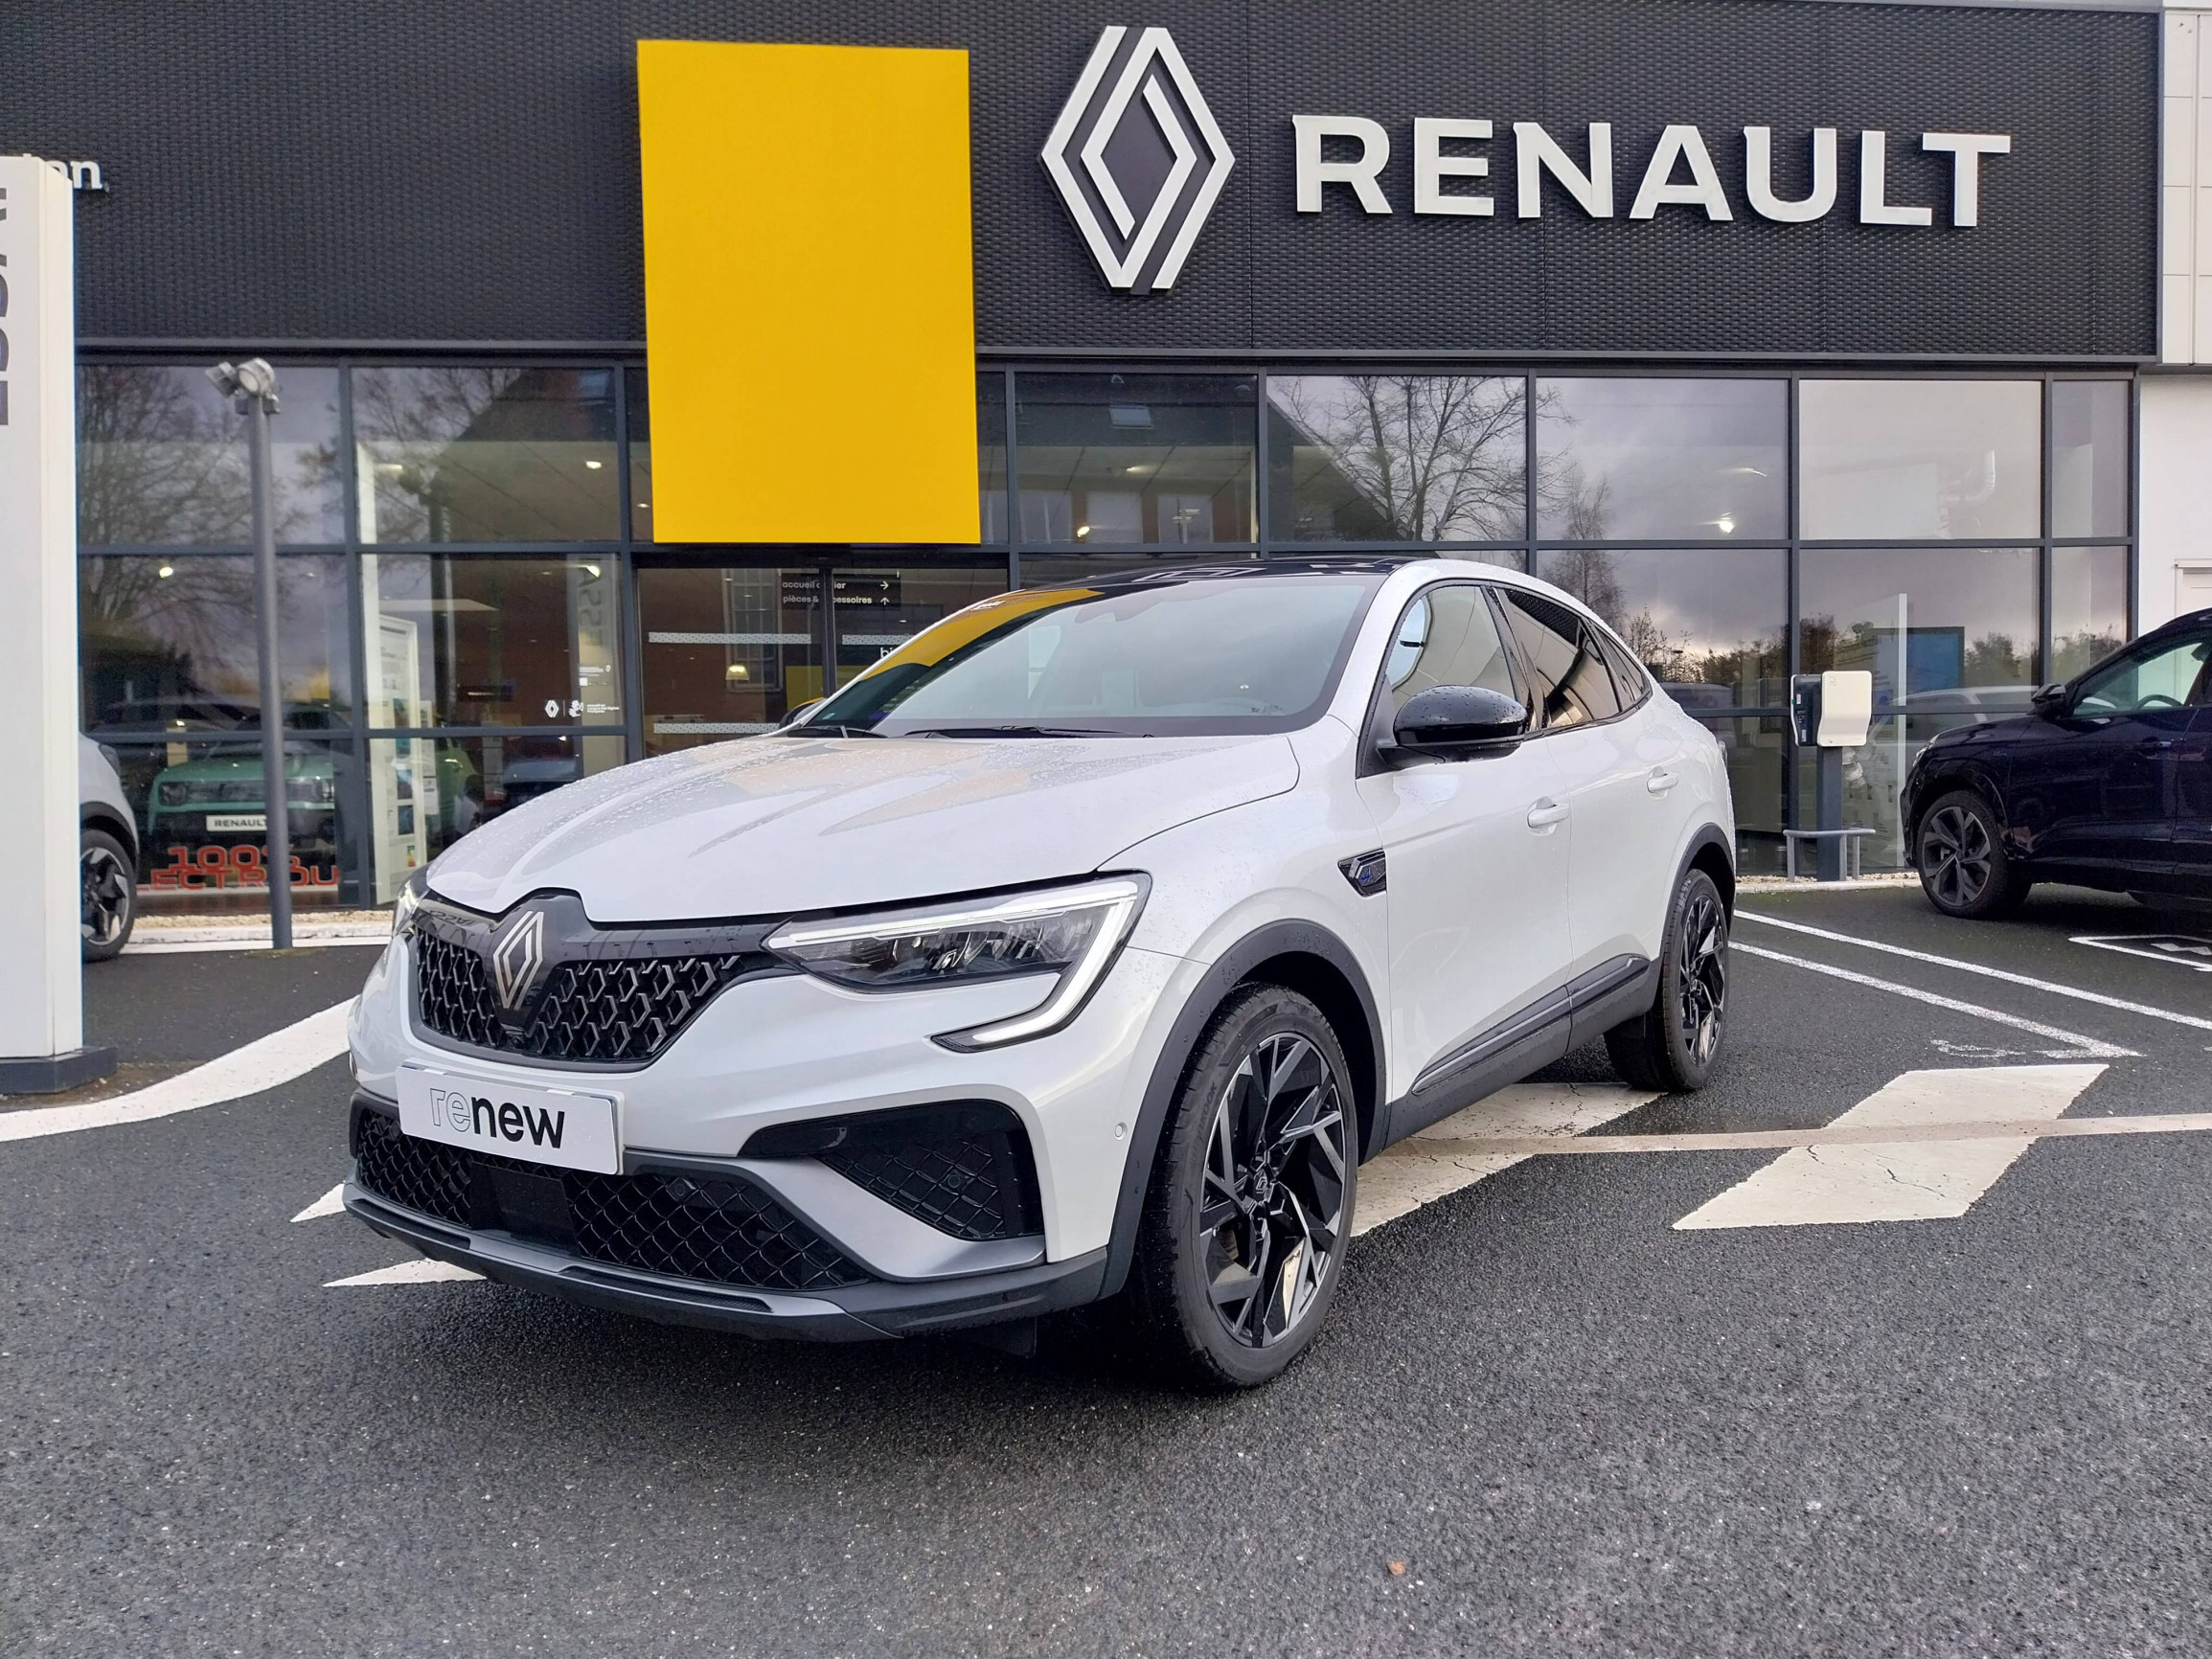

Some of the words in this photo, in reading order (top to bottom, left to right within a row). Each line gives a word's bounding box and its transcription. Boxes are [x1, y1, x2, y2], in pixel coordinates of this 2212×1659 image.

[1292, 113, 2012, 227] RENAULT
[783, 595, 811, 603] pièces
[430, 1088, 565, 1148] renew
